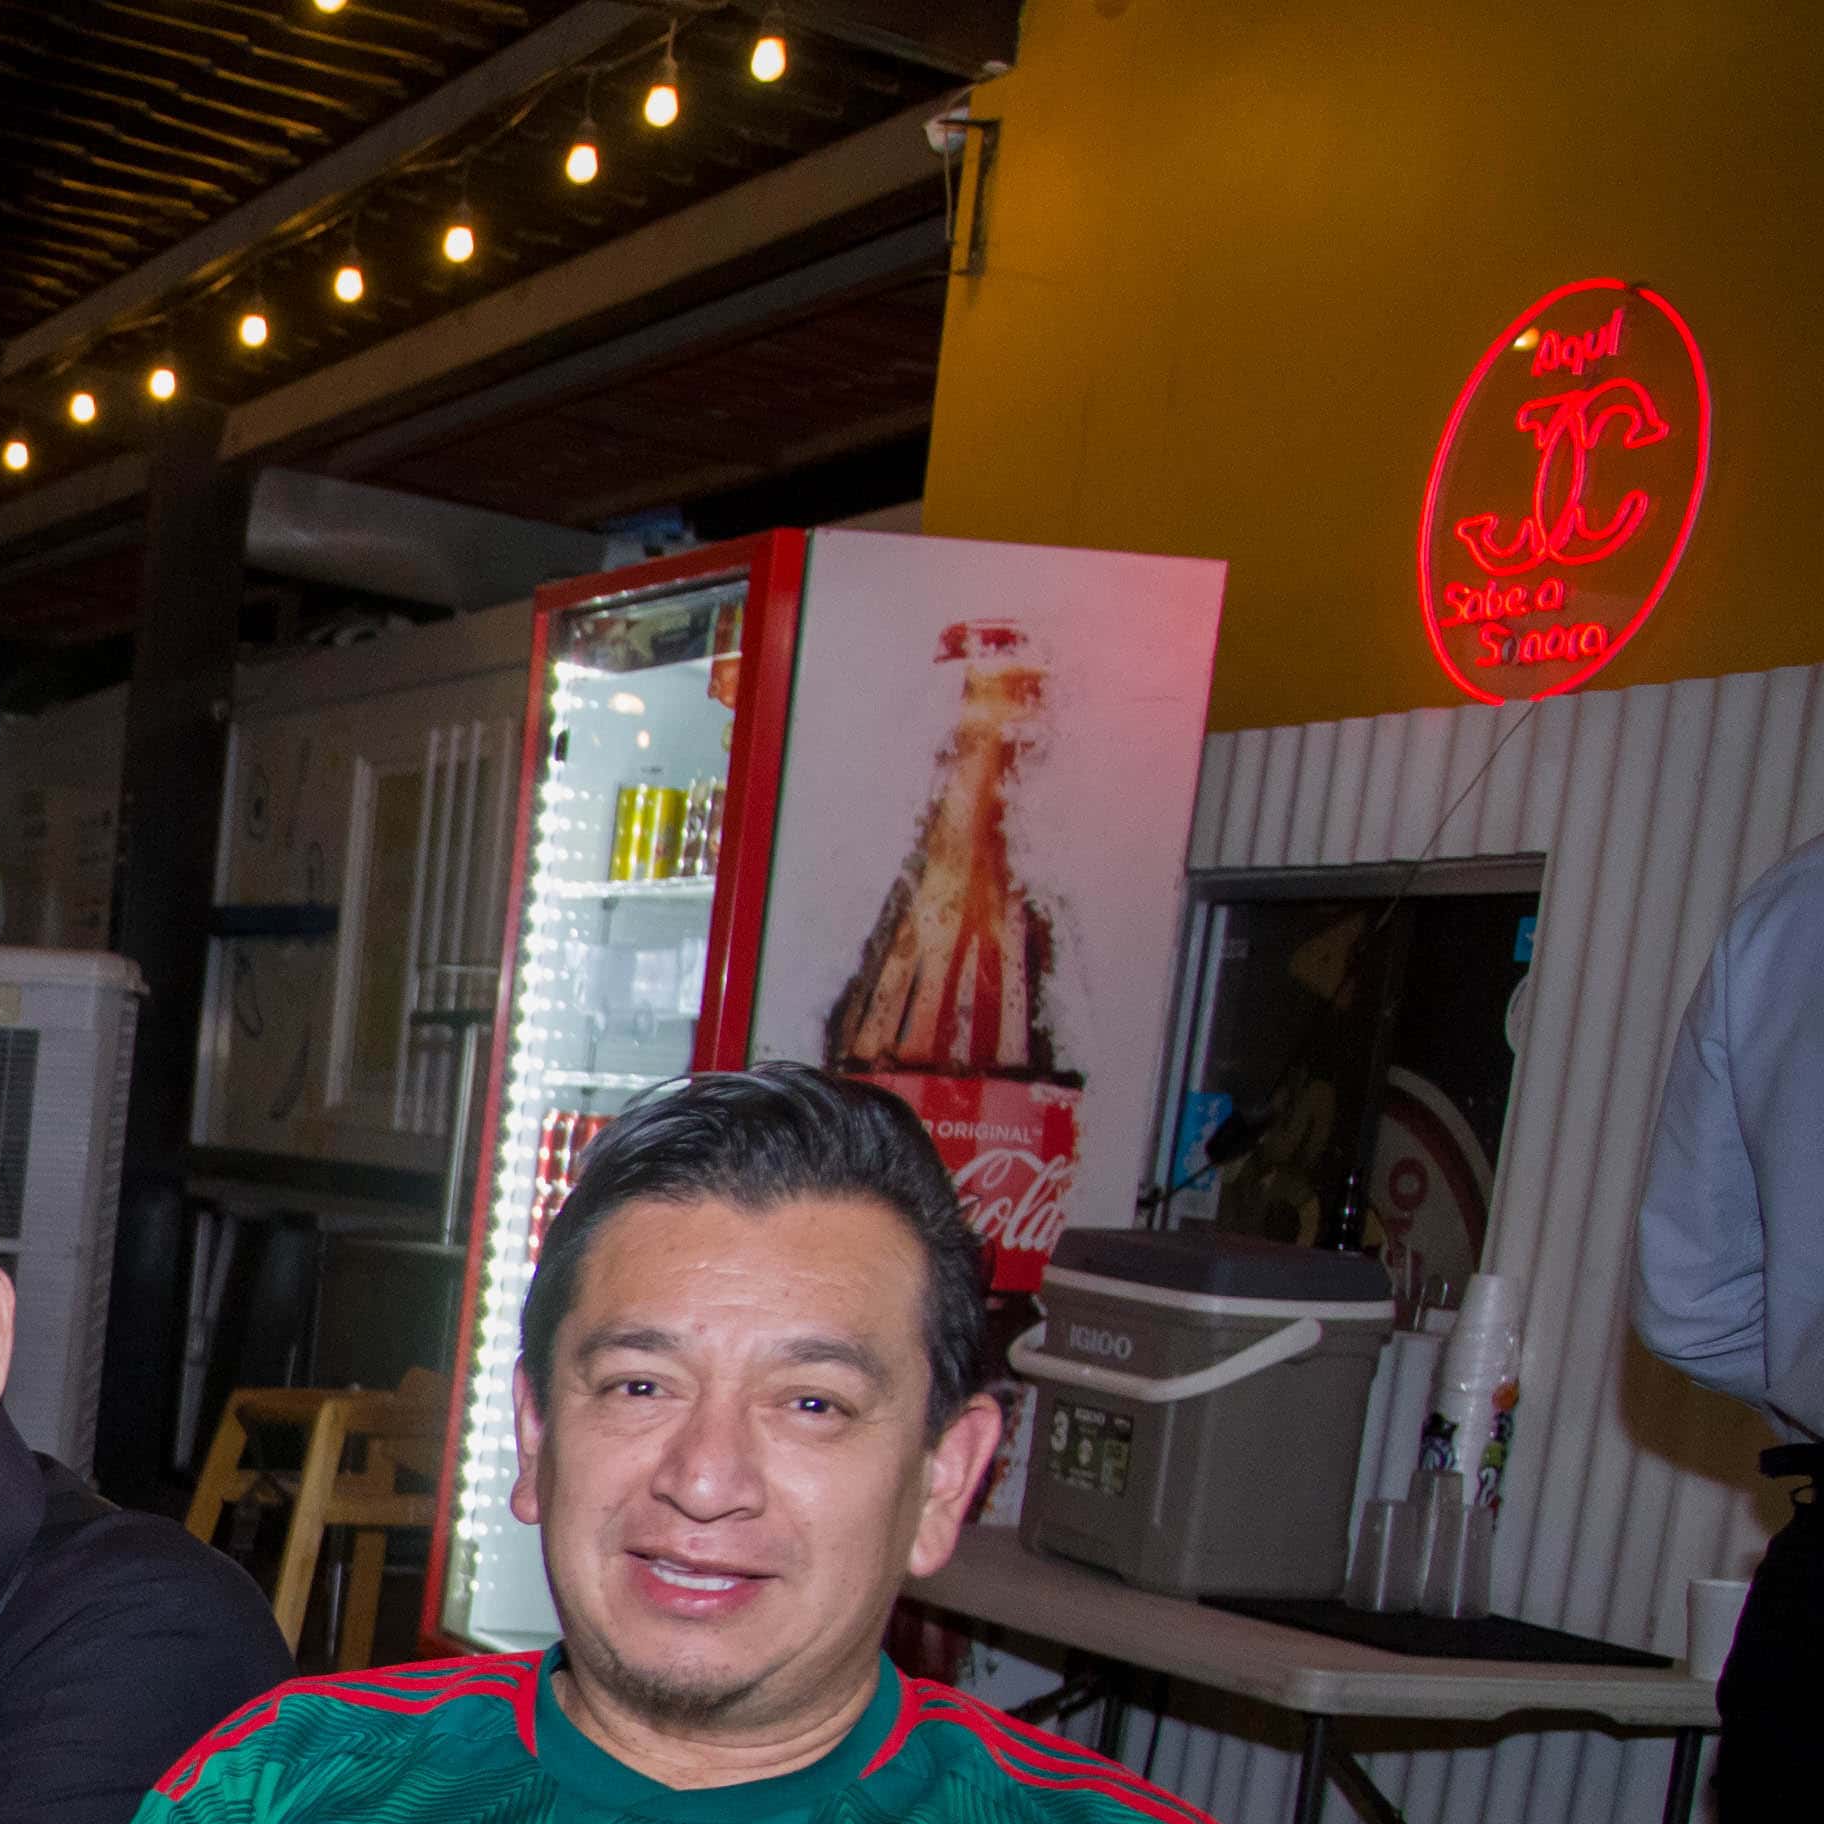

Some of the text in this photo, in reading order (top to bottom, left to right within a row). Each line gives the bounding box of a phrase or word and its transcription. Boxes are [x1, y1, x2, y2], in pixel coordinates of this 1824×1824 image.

[1440, 576, 1564, 627] Sabe a
[938, 1120, 1033, 1145] ORIGINAL
